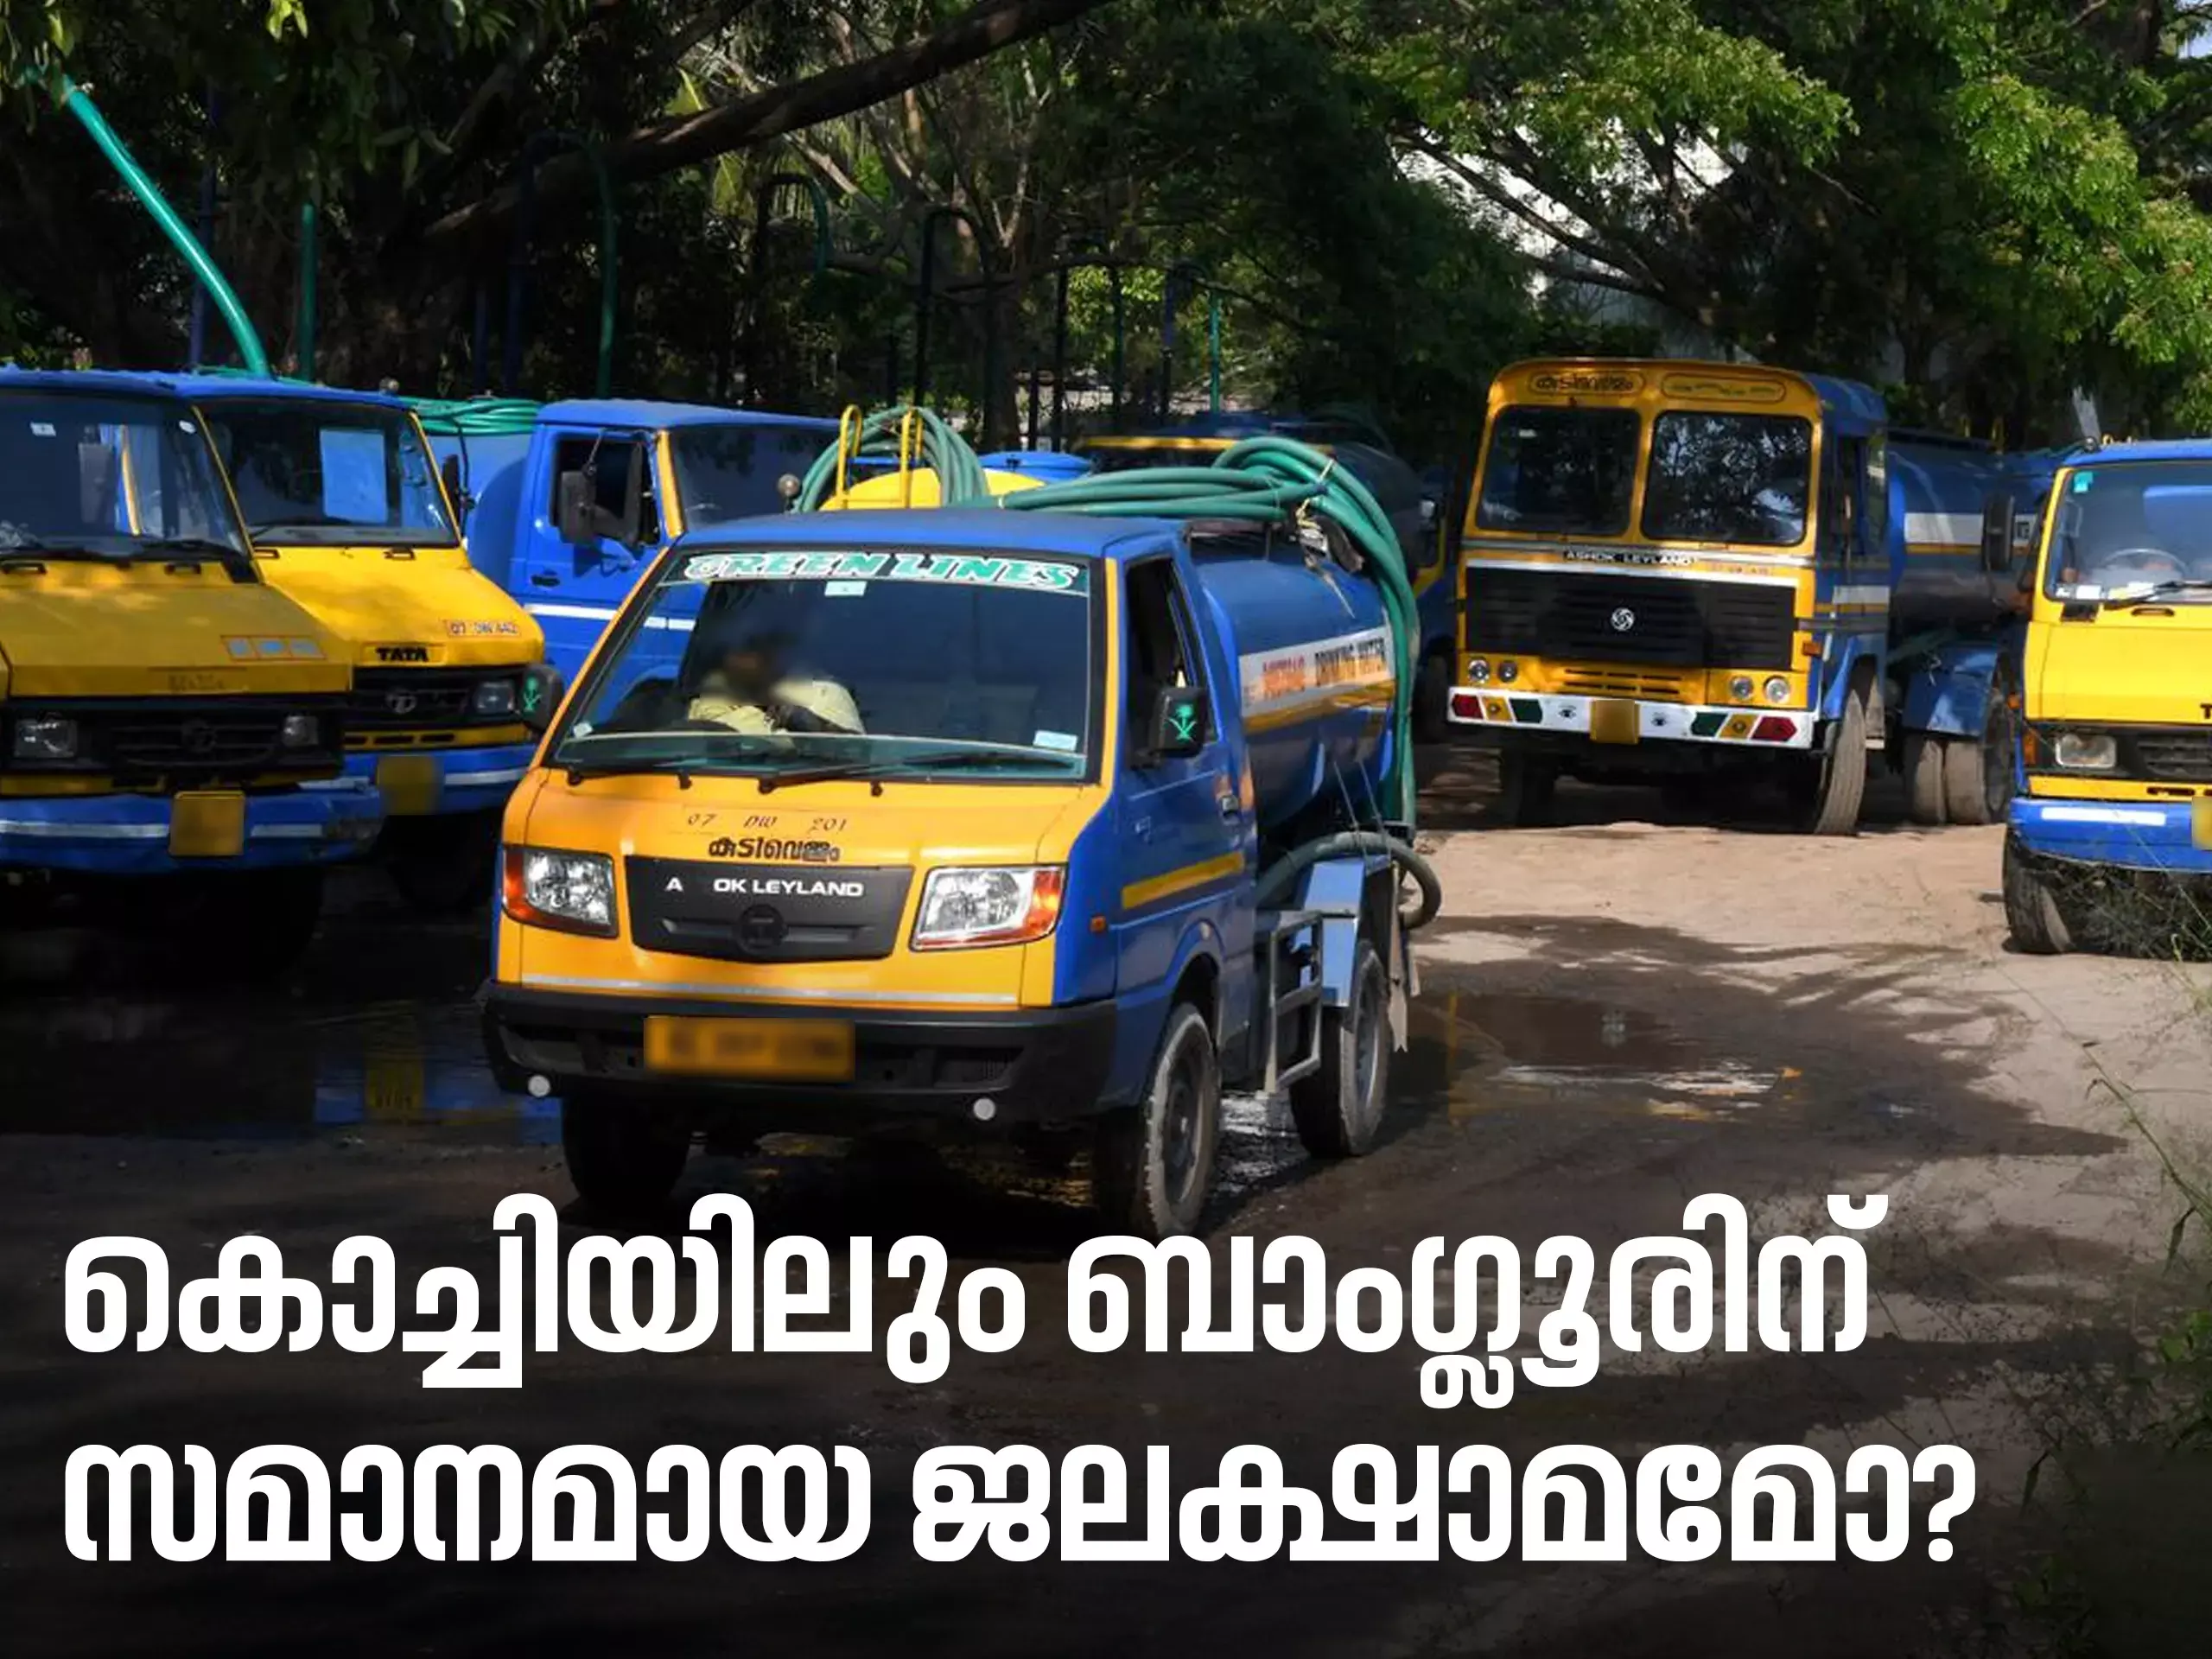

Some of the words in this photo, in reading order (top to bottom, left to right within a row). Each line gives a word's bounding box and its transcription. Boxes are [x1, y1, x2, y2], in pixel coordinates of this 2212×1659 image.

[684, 551, 887, 580] GREEN
[890, 553, 1077, 589] LINES
[376, 647, 429, 662] TATA
[688, 813, 717, 827] 07
[752, 880, 864, 898] LEYLAND
